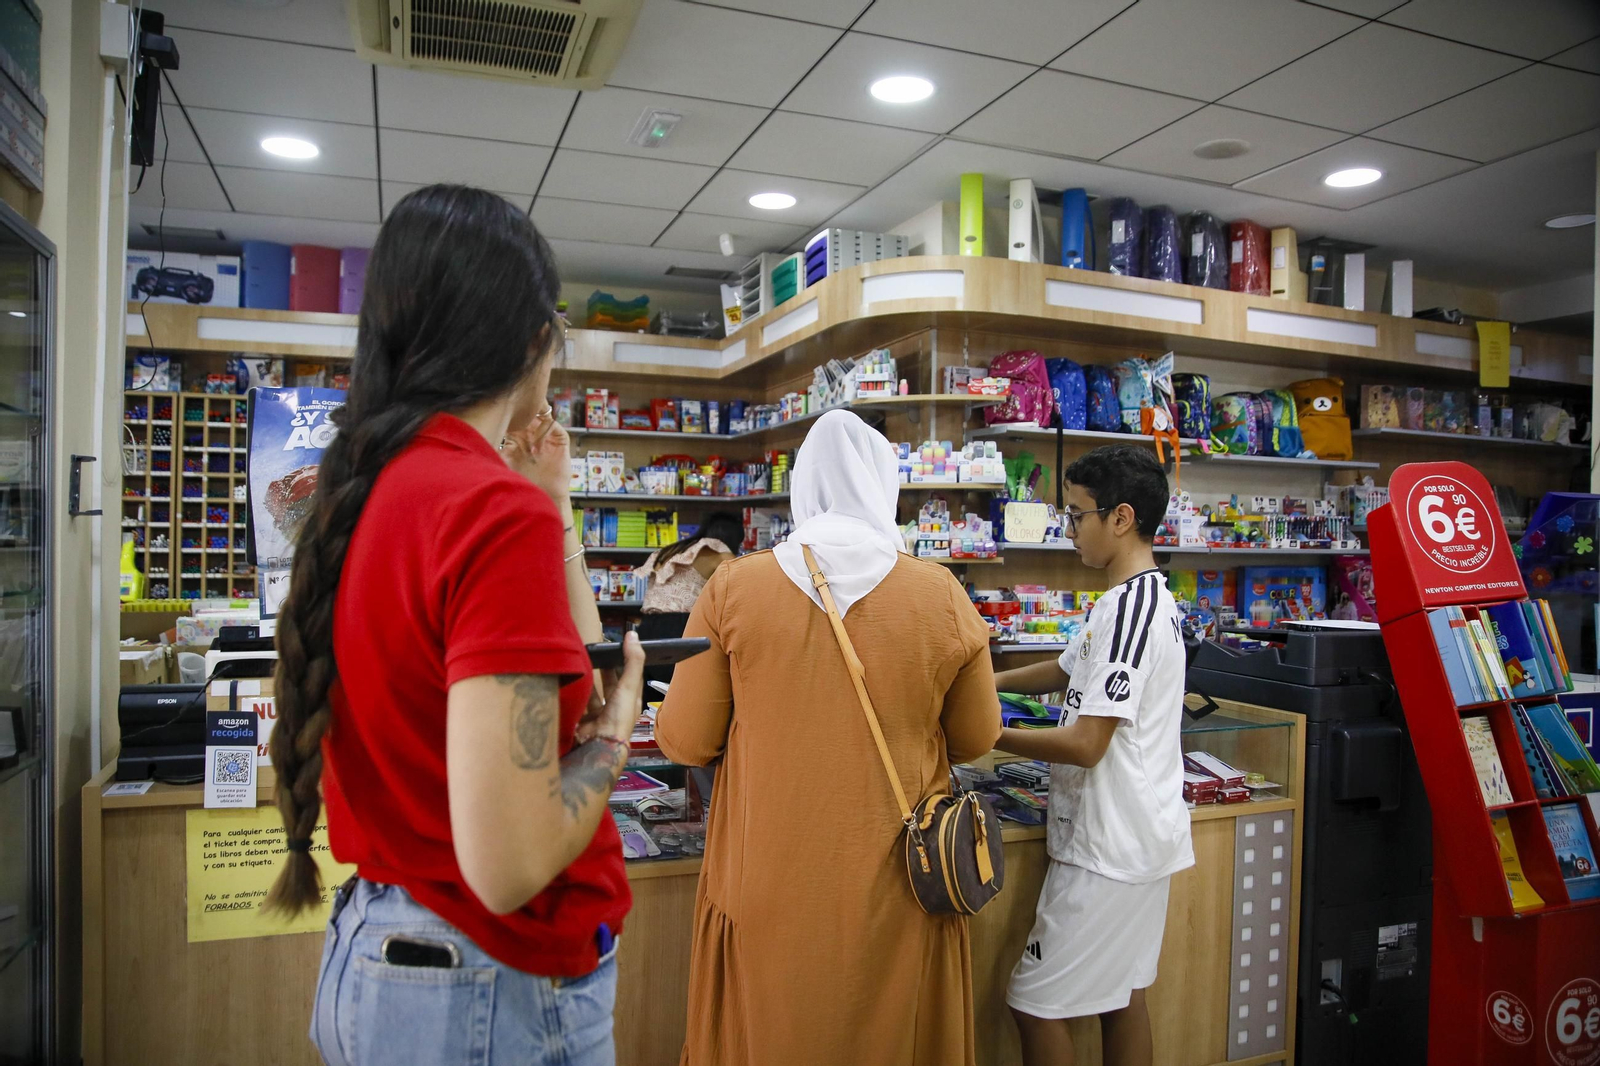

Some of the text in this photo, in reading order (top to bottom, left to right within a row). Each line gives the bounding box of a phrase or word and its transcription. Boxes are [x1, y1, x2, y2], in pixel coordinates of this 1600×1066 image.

[1423, 484, 1455, 493] POR SOLO
[1441, 544, 1476, 553] BESTSELLER
[1431, 545, 1489, 568] PRECIO INCREÍBLE
[1424, 580, 1519, 594] NEWTON COMPTON EDITORES
[1106, 673, 1130, 699] hp
[218, 718, 249, 727] amazon
[211, 728, 254, 738] recogida
[227, 828, 262, 837] cualquier
[253, 838, 284, 847] compra.
[1553, 839, 1583, 849] RFECTA
[220, 850, 242, 858] libros
[245, 848, 269, 856] deben
[240, 859, 275, 869] etiqueta.
[204, 893, 217, 901] No
[204, 901, 252, 911] FORRADOS
[1579, 986, 1592, 994] SOLO
